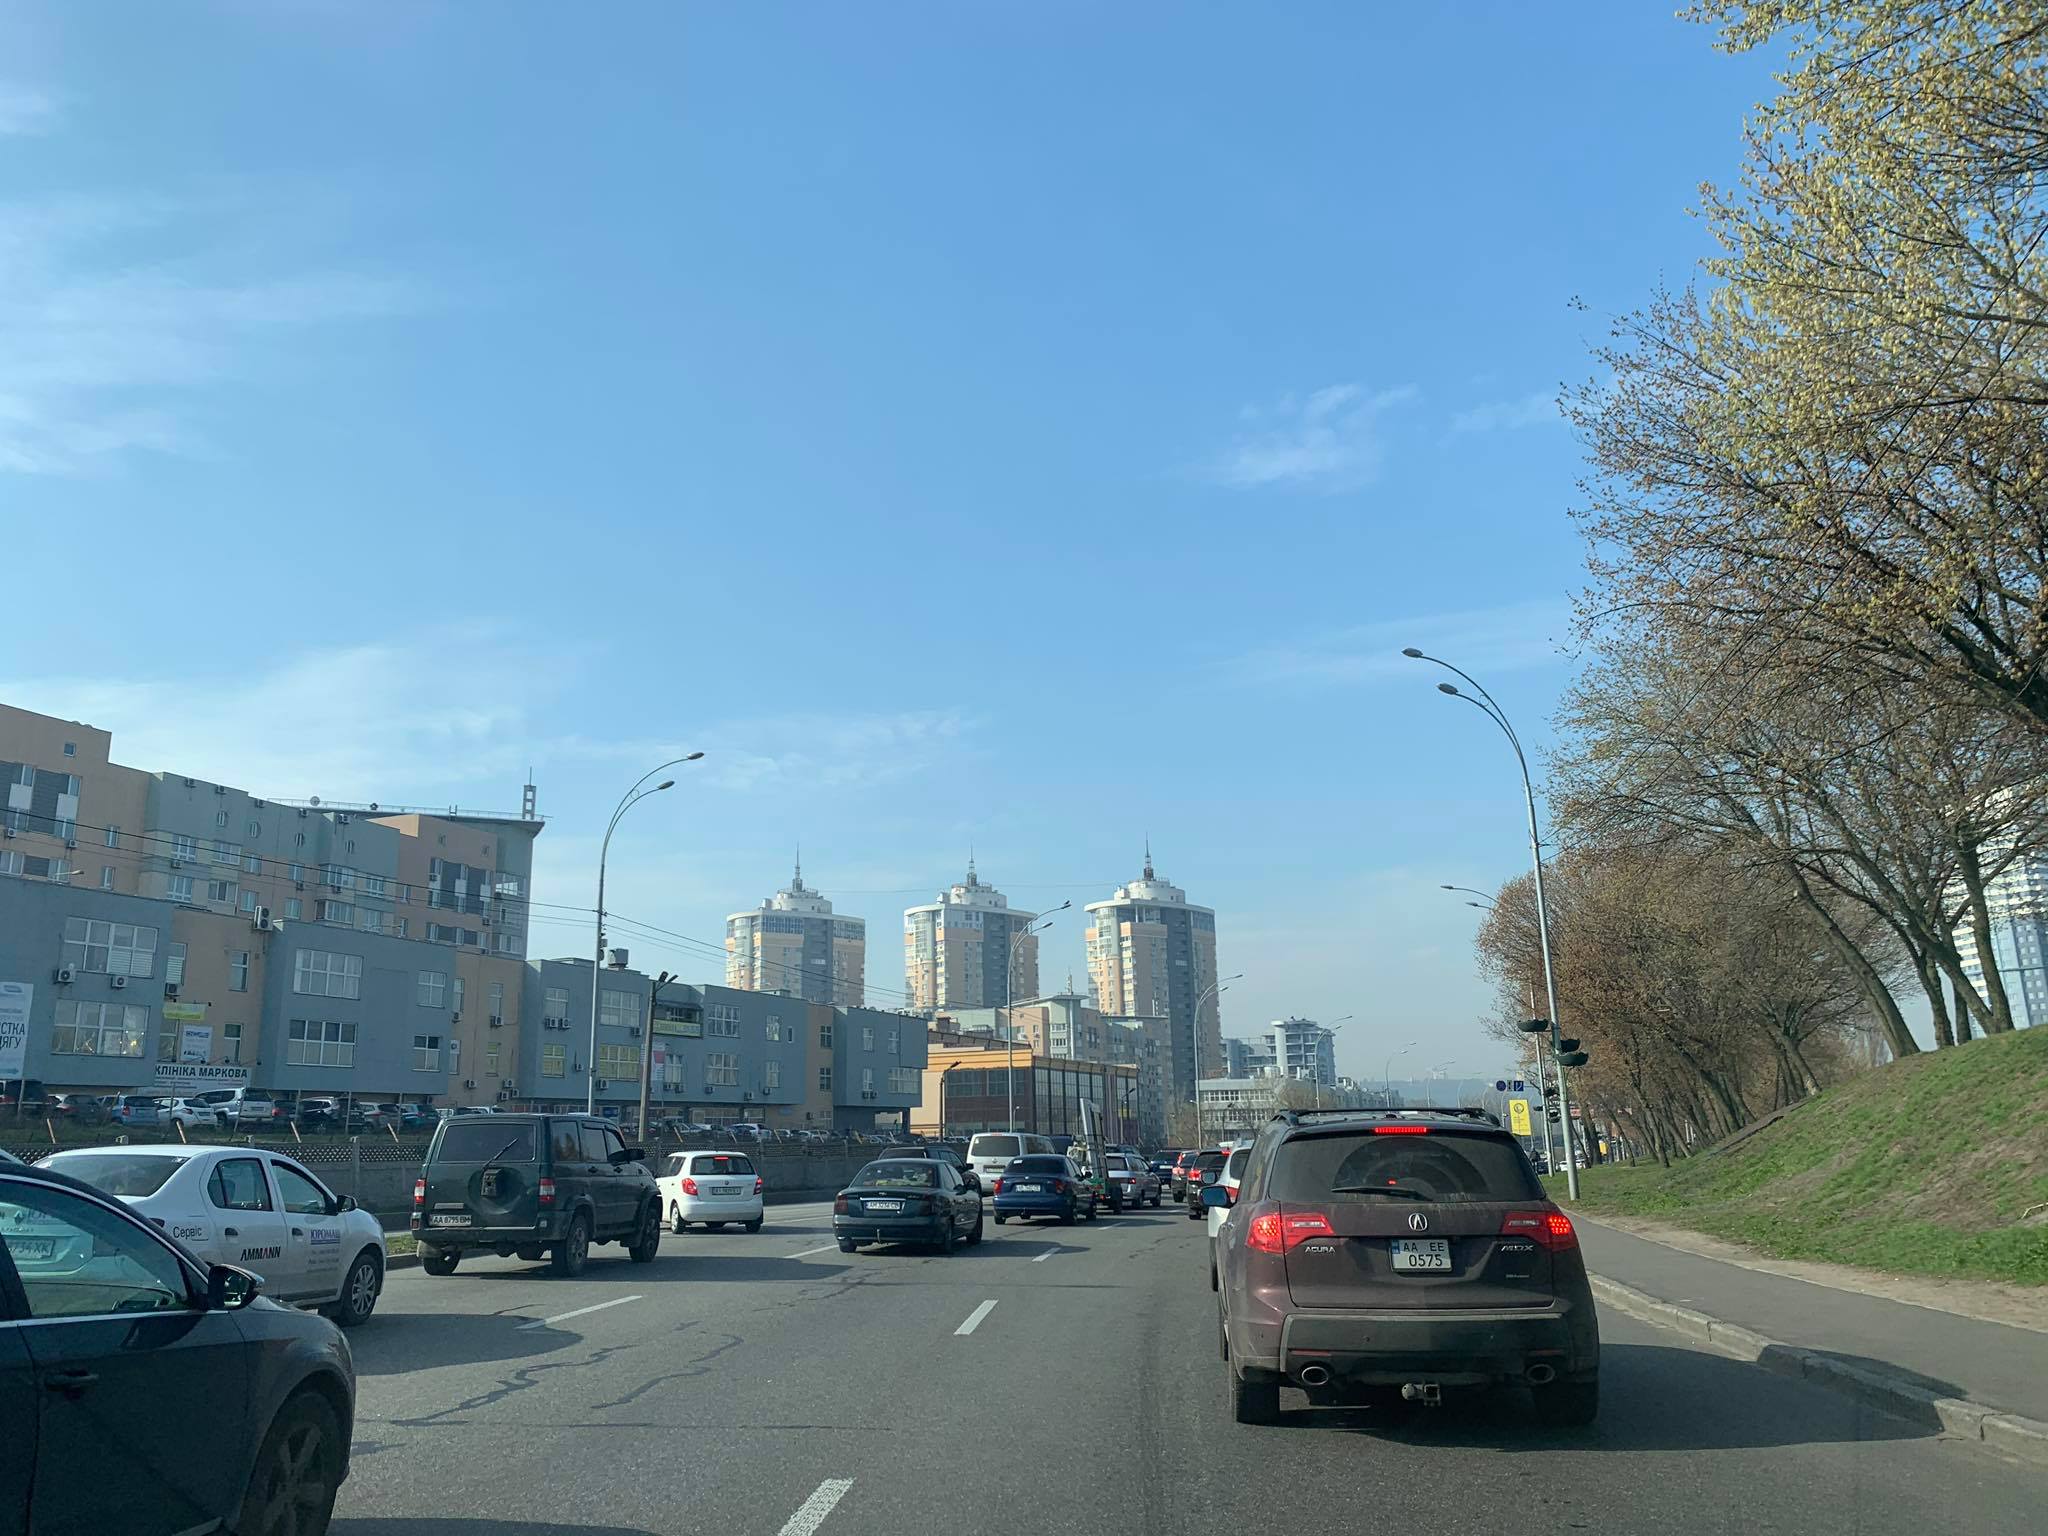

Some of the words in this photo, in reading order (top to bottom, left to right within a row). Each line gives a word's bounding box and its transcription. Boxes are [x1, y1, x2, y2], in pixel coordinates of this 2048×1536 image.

[0, 1022, 25, 1035] СТКА
[199, 1067, 248, 1078] МАРКОВА
[1403, 1242, 1418, 1252] AA
[1429, 1242, 1445, 1252] EE
[240, 1246, 281, 1262] AMMANN
[1408, 1254, 1443, 1267] 0575
